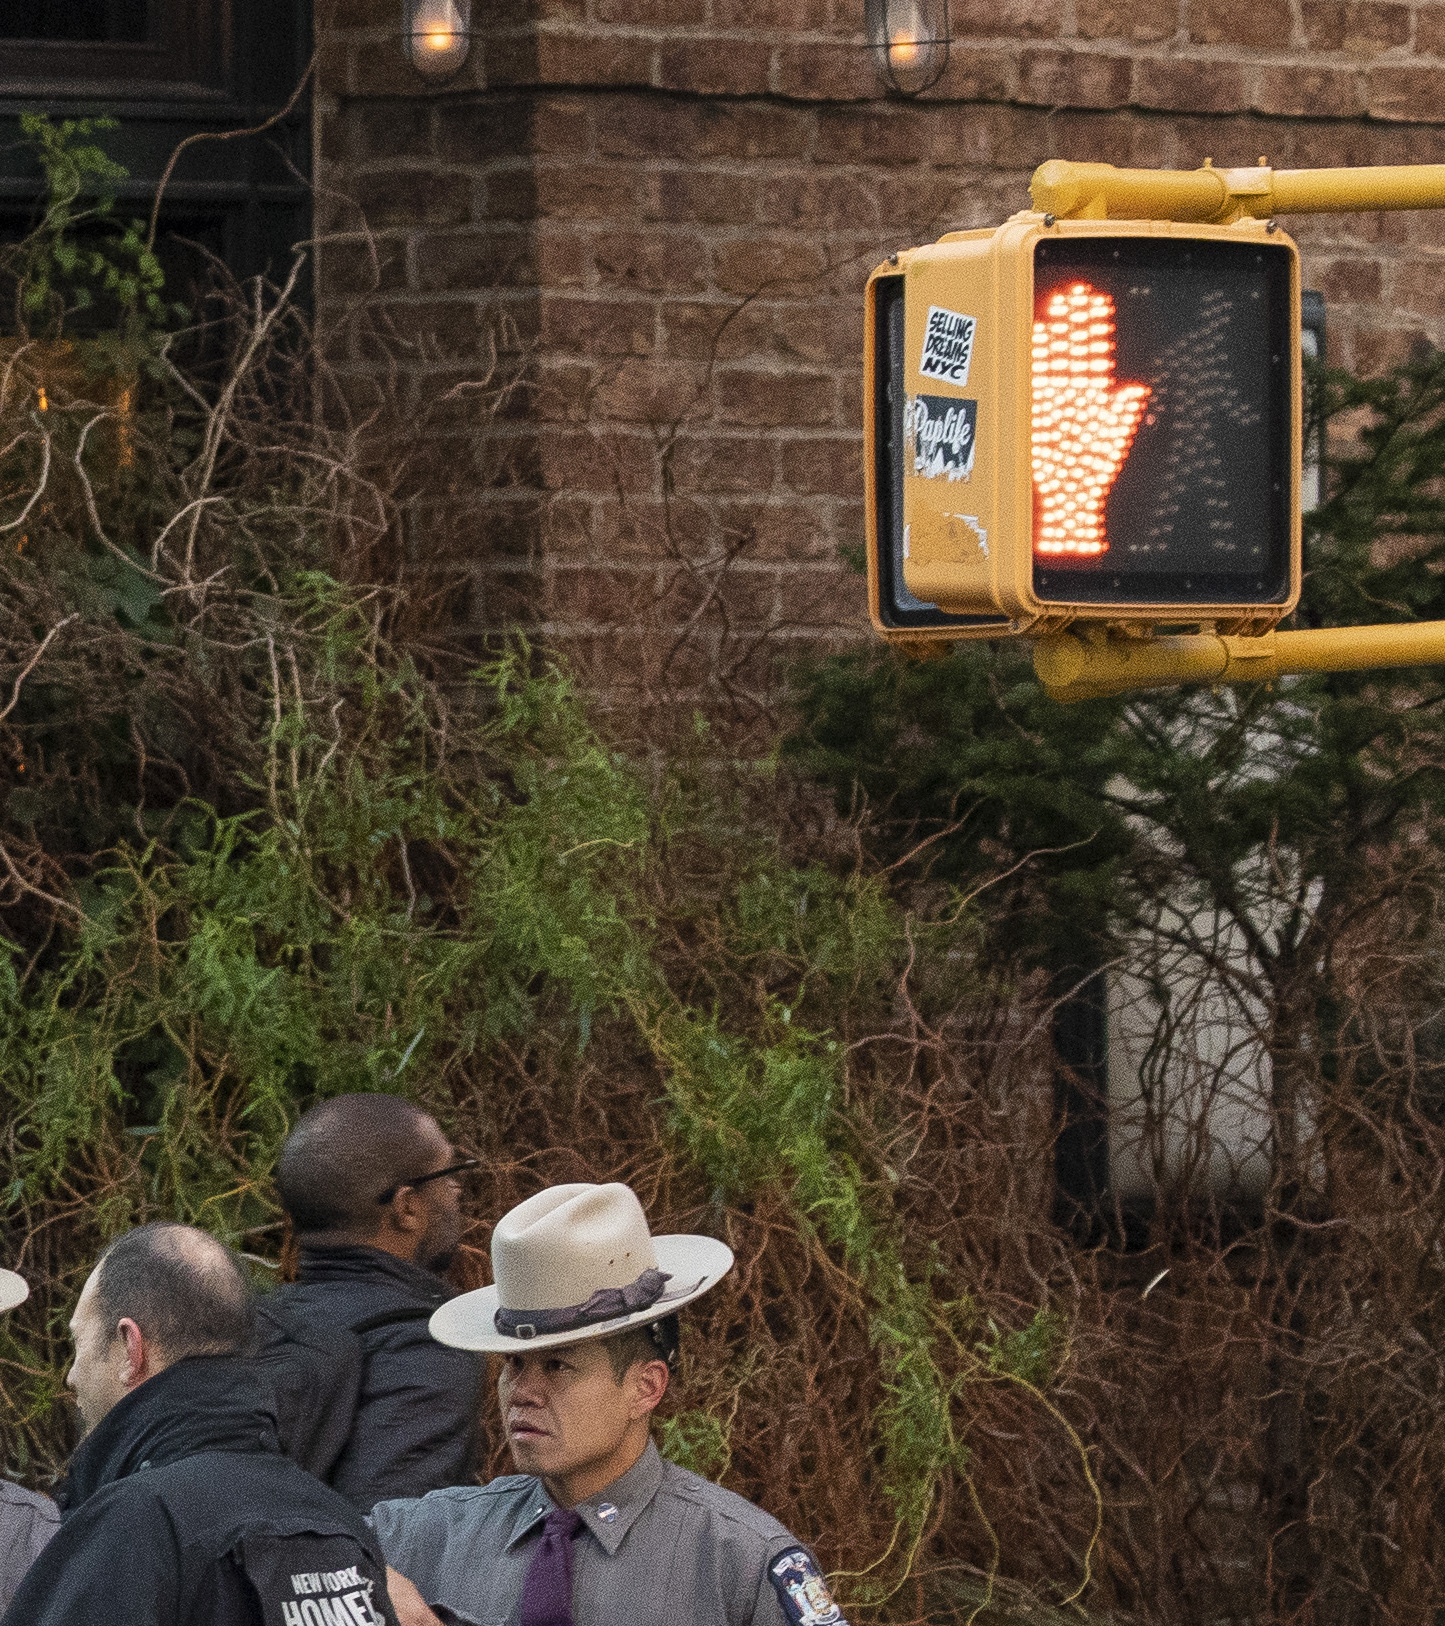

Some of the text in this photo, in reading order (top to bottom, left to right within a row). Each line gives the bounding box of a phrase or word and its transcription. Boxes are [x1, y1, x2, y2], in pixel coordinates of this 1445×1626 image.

[929, 311, 973, 342] SELLING
[925, 333, 970, 365] DREAMS
[922, 357, 966, 380] NYC
[290, 1571, 323, 1595] NEW
